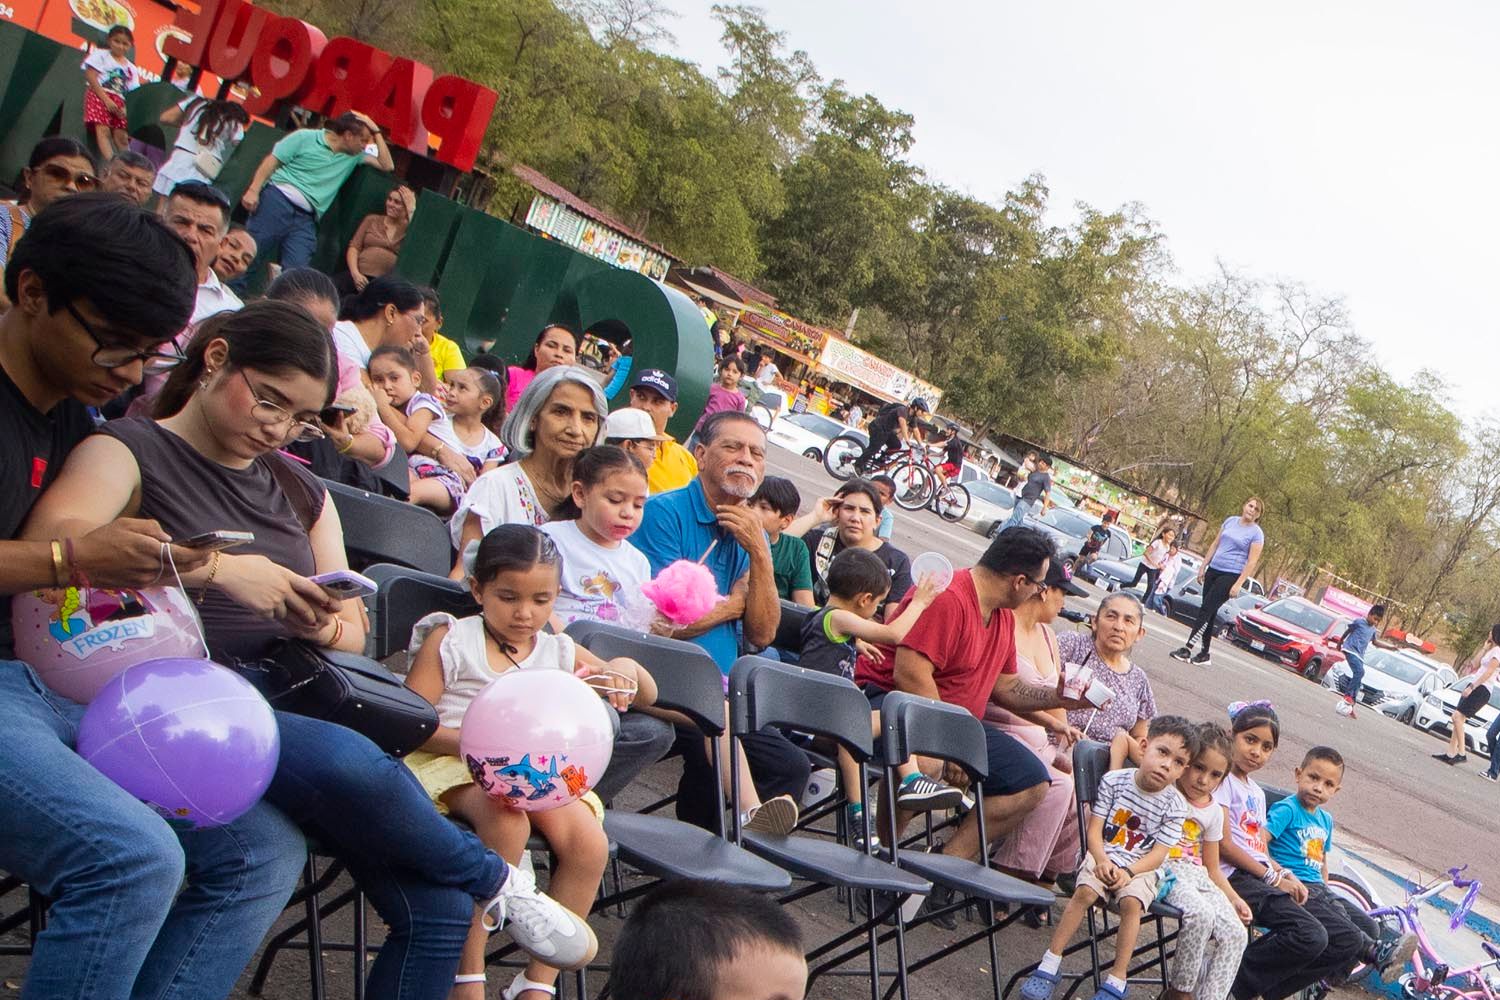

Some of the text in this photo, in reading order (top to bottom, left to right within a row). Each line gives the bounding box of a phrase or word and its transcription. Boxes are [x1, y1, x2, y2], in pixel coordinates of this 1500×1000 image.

[641, 375, 669, 390] adidas
[72, 619, 148, 655] FROZEN
[1112, 808, 1142, 831] NO
